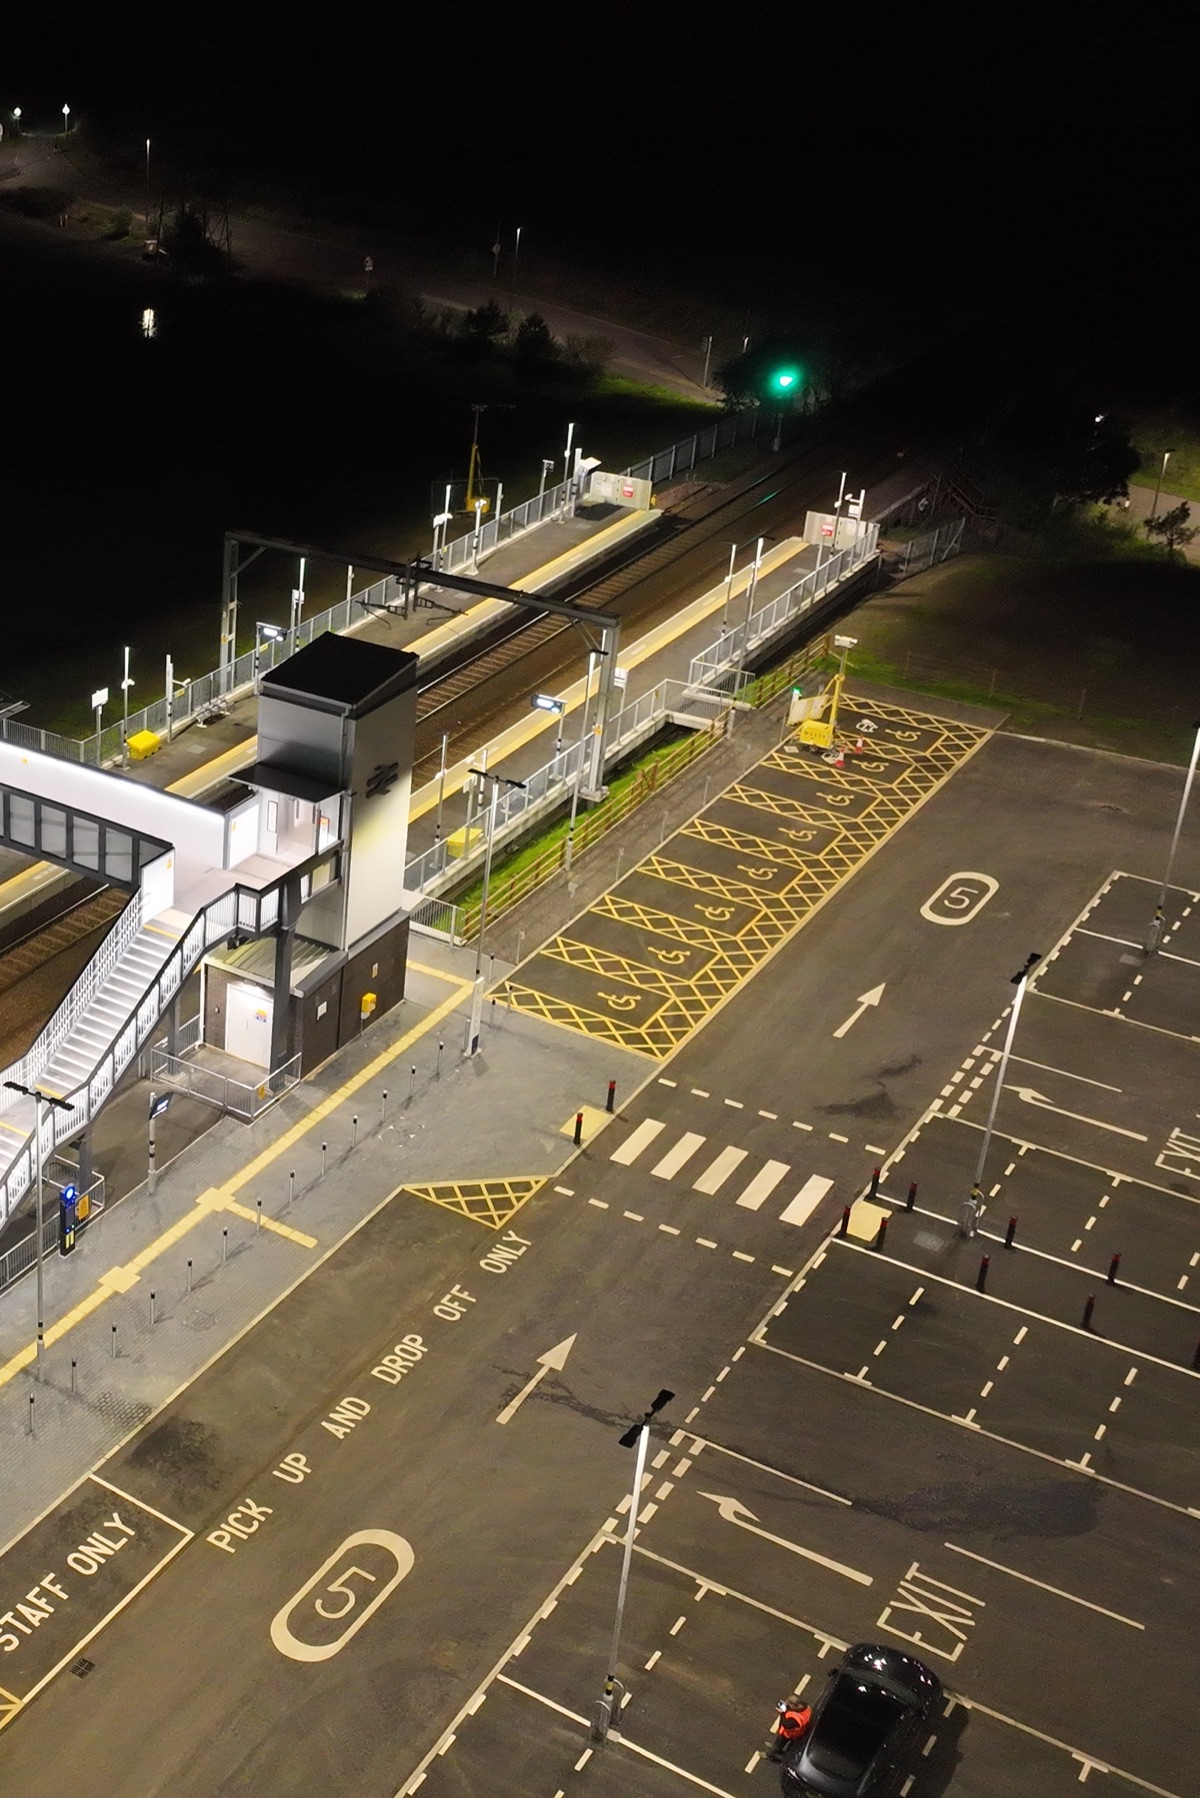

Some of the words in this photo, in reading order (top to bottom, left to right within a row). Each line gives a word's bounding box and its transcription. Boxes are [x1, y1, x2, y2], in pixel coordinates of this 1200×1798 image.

[944, 886, 979, 909] 5
[206, 1498, 273, 1553] PICK
[272, 1453, 312, 1483] UP
[320, 1397, 371, 1439] AND
[371, 1334, 428, 1385] DROP
[433, 1284, 476, 1321] OFF
[479, 1230, 532, 1273] ONLY
[66, 1512, 135, 1575] ONLY
[315, 1566, 376, 1619] 5
[877, 1561, 986, 1662] EXIT
